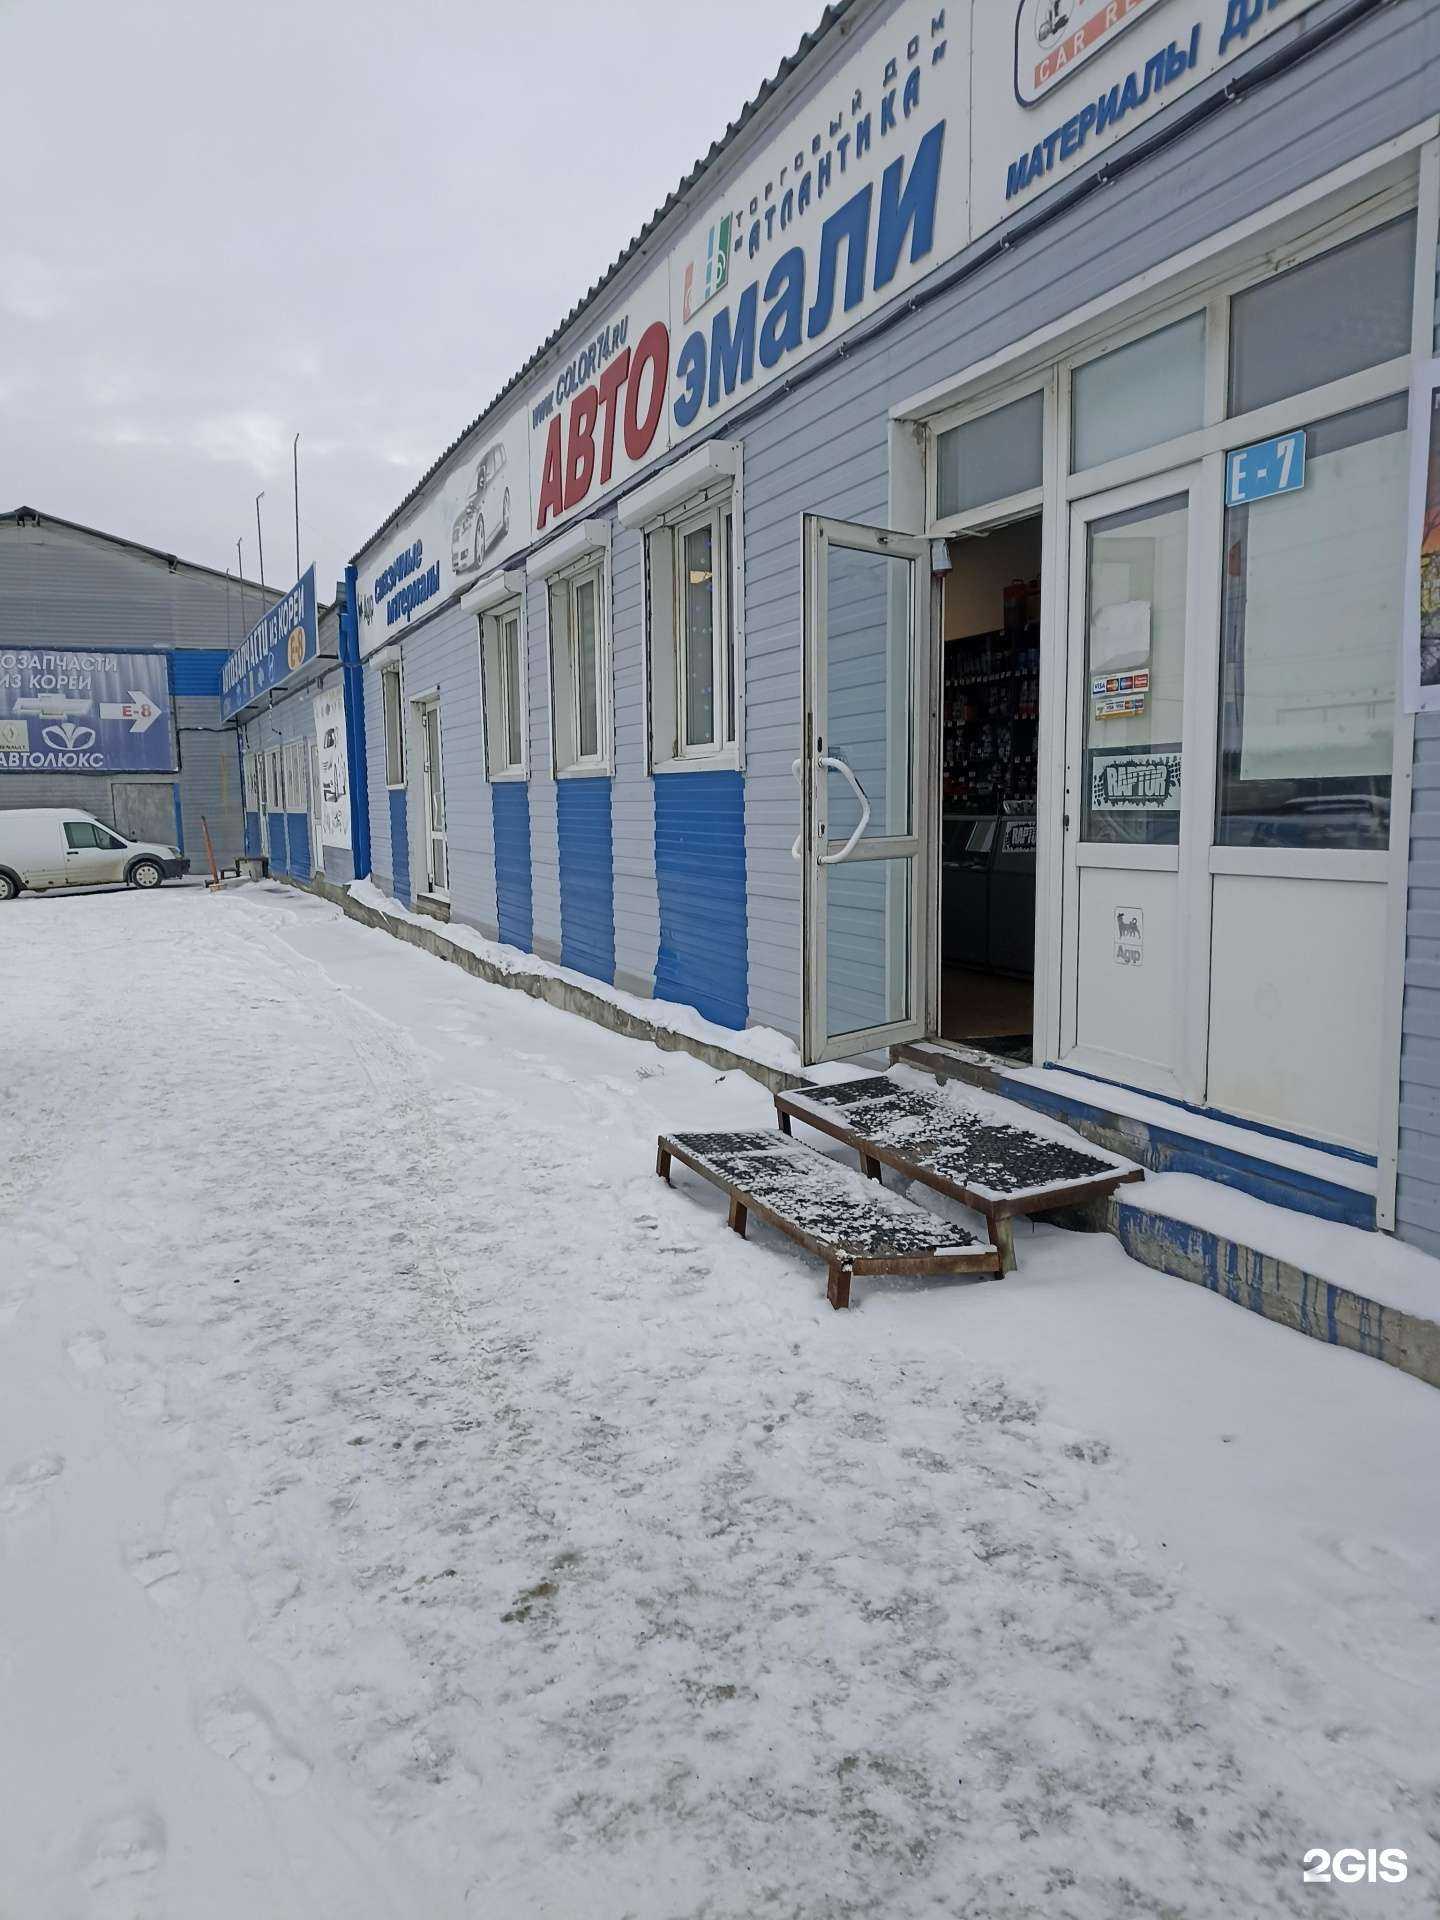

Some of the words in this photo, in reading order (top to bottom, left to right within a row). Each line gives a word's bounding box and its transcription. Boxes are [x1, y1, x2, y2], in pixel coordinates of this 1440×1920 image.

[883, 8, 945, 87] ДОМ
[1039, 29, 1086, 83] CAR
[1006, 22, 1200, 200] МАТЕРИАЛЫ
[536, 320, 671, 530] АВТО
[29, 675, 92, 690] КОРЕИ
[0, 752, 104, 767] АВТОЛЮКС
[1106, 764, 1168, 797] RAPTOR
